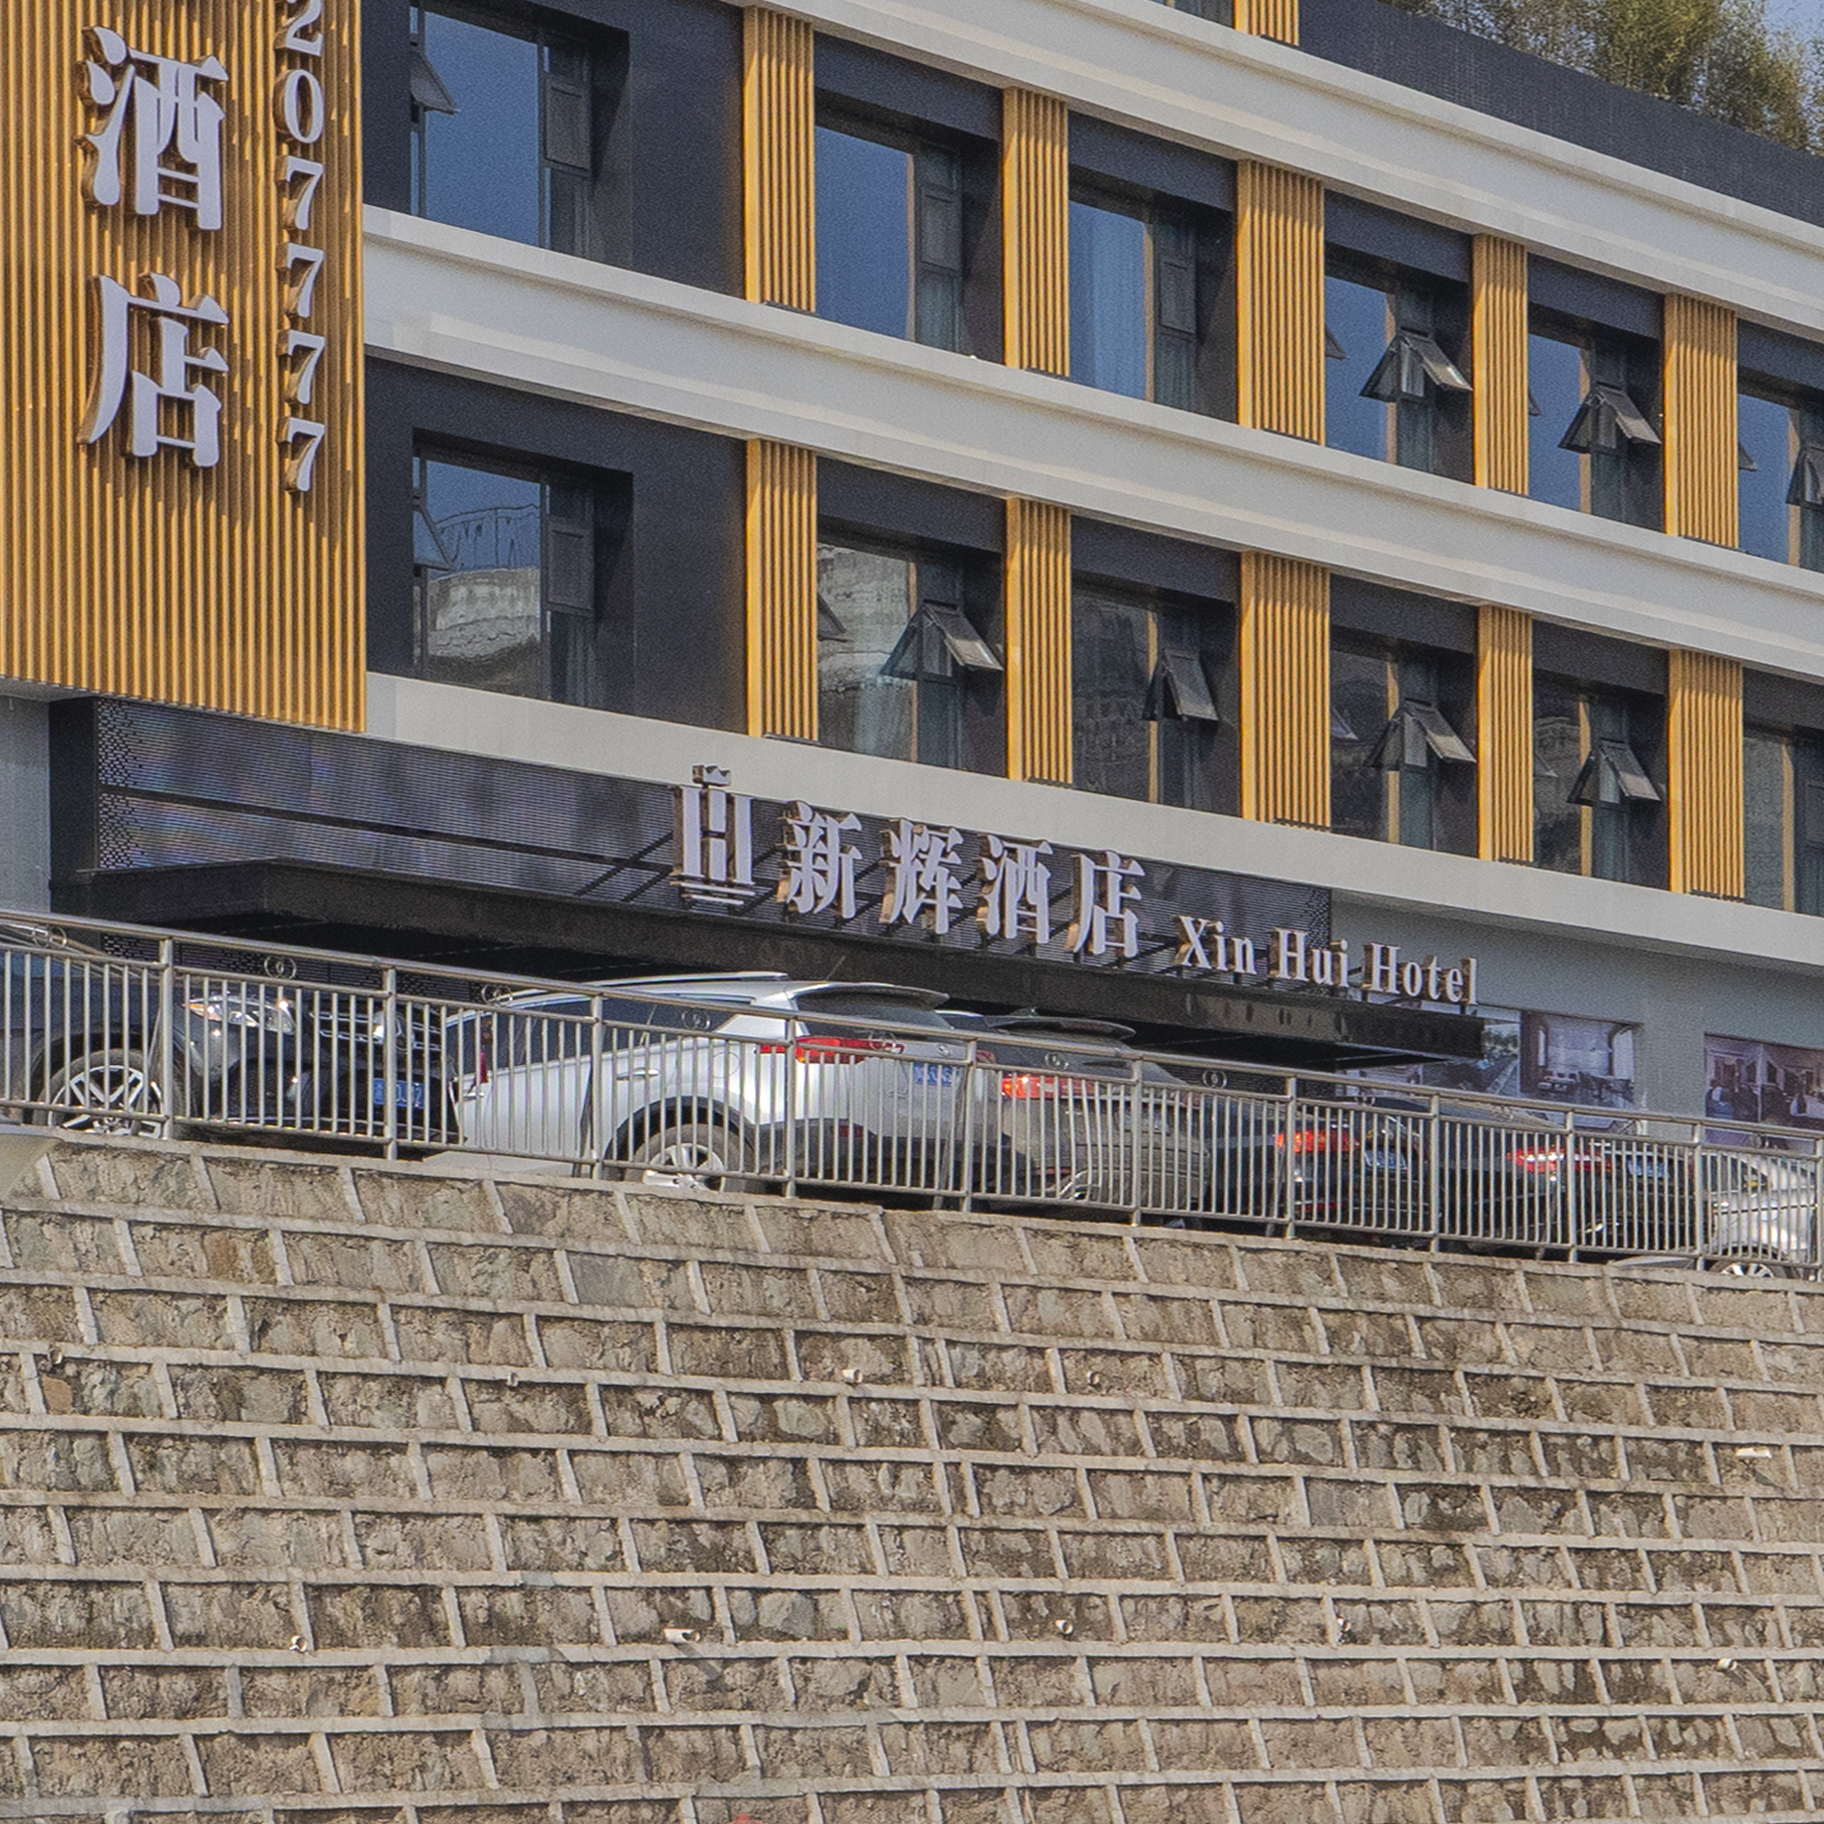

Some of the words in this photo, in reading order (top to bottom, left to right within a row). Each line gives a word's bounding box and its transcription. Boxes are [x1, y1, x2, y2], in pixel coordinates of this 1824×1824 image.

[778, 800, 1145, 957] 新辉酒店
[1175, 915, 1257, 975] Xin
[1269, 927, 1350, 988] Hui
[1364, 942, 1478, 1006] Hotel
